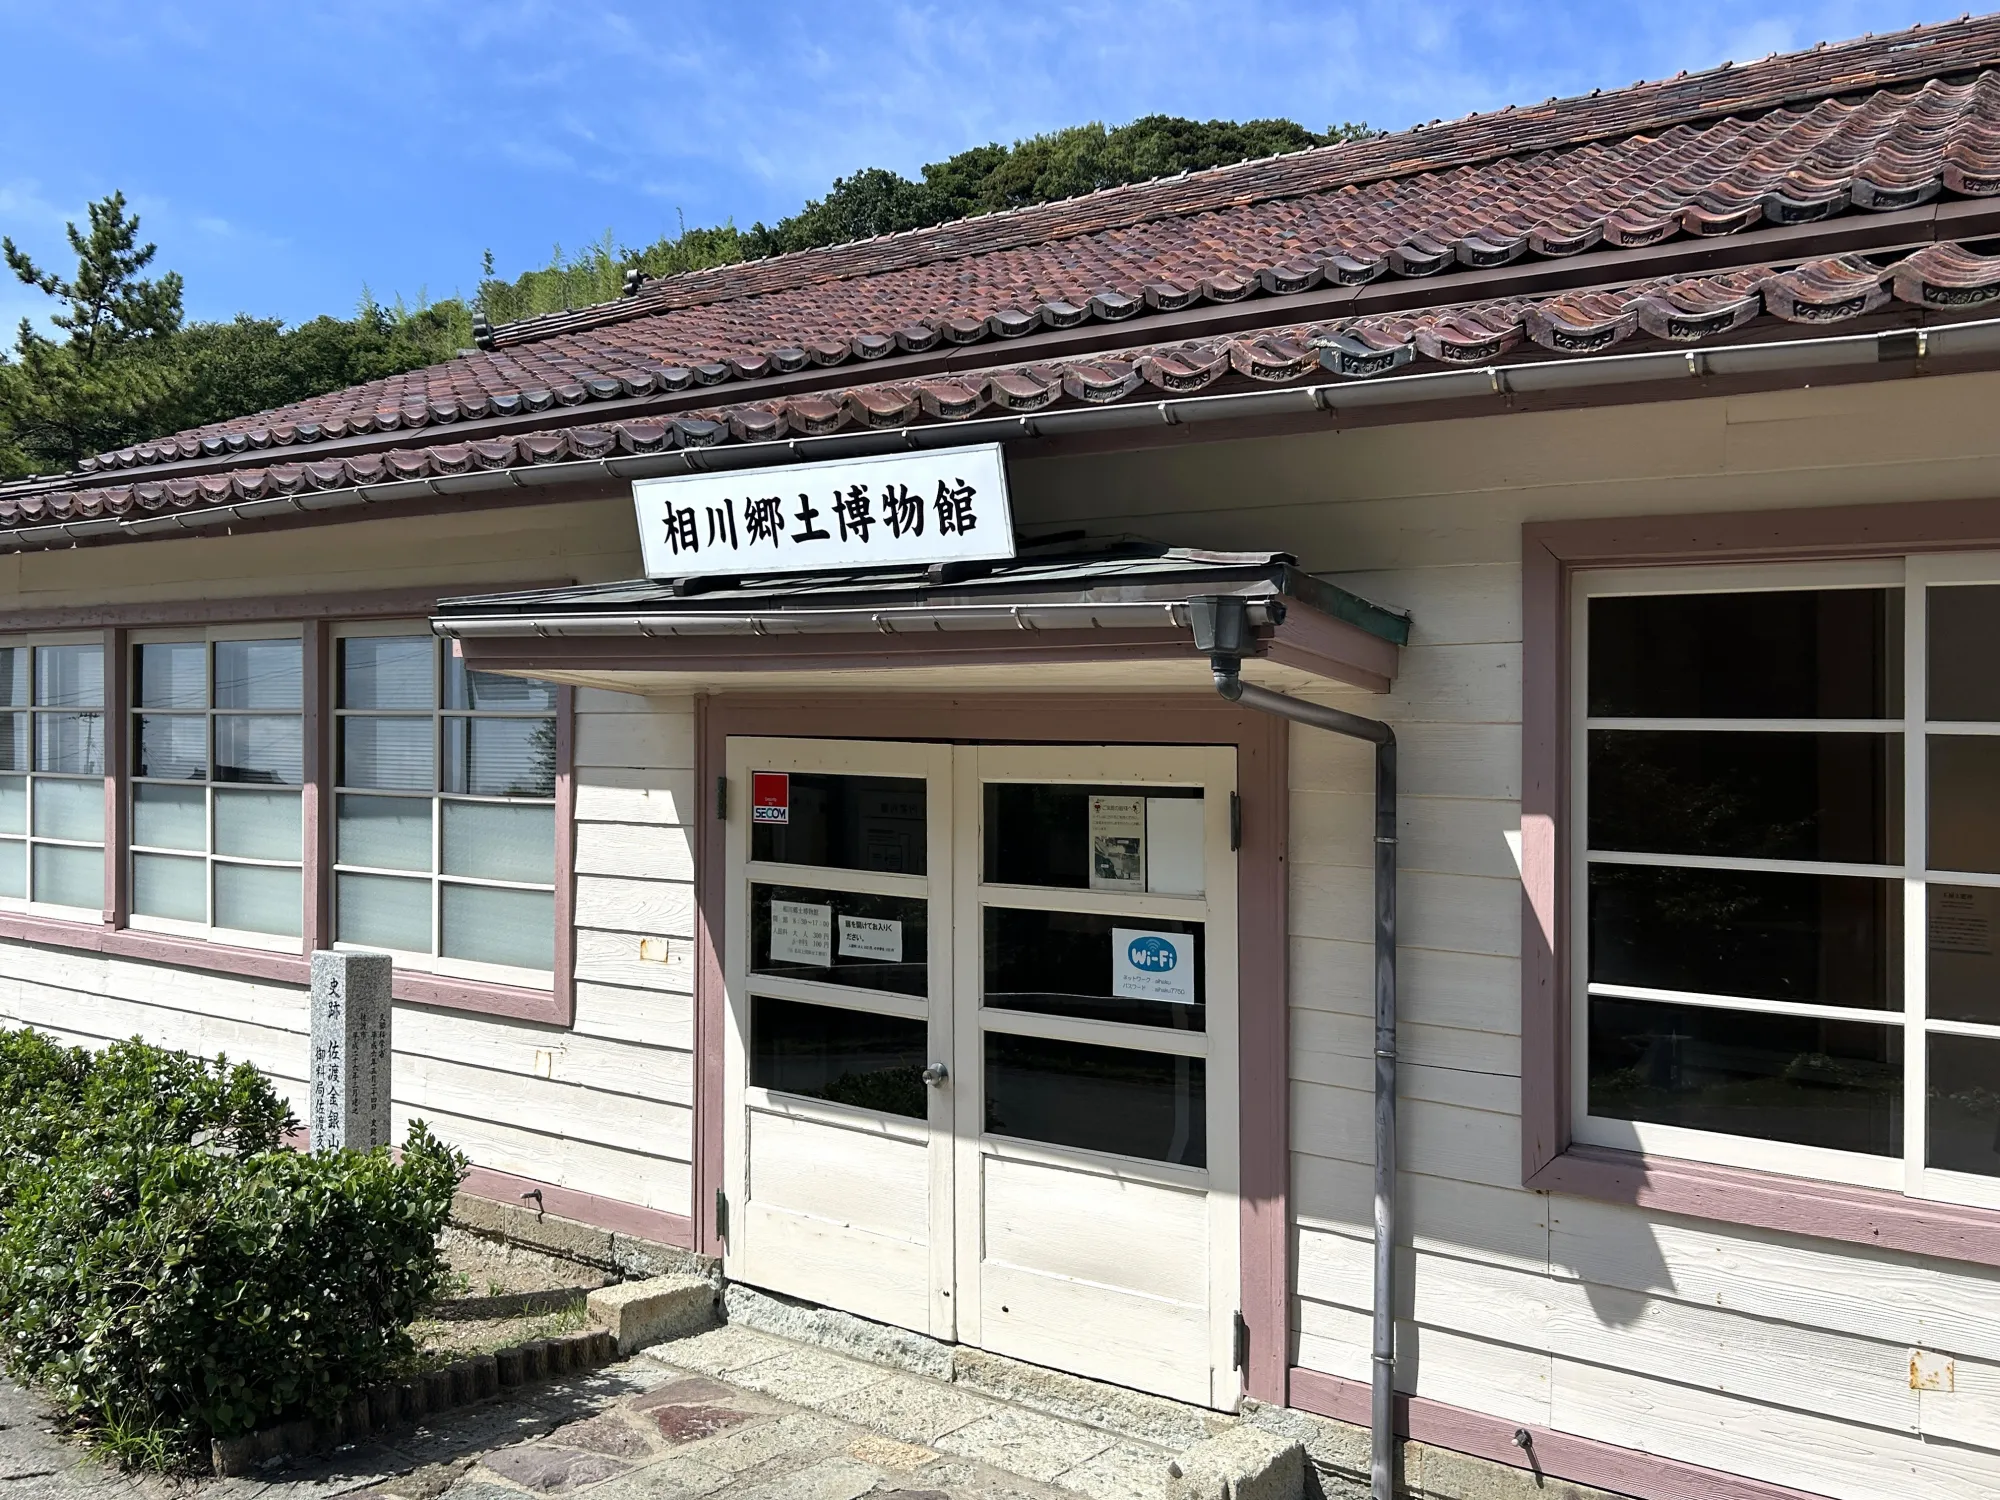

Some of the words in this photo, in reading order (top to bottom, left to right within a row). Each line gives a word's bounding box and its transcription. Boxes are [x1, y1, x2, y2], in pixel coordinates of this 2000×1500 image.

[662, 477, 977, 555] 相川郷土博物館
[755, 807, 786, 819] SECOM
[845, 920, 892, 932] 扉を開けてお入りく
[846, 933, 864, 942] ださい。
[1131, 948, 1173, 968] Wi-Fi
[328, 977, 341, 1021] 史跡
[327, 1040, 341, 1151] 佐渡金銀山
